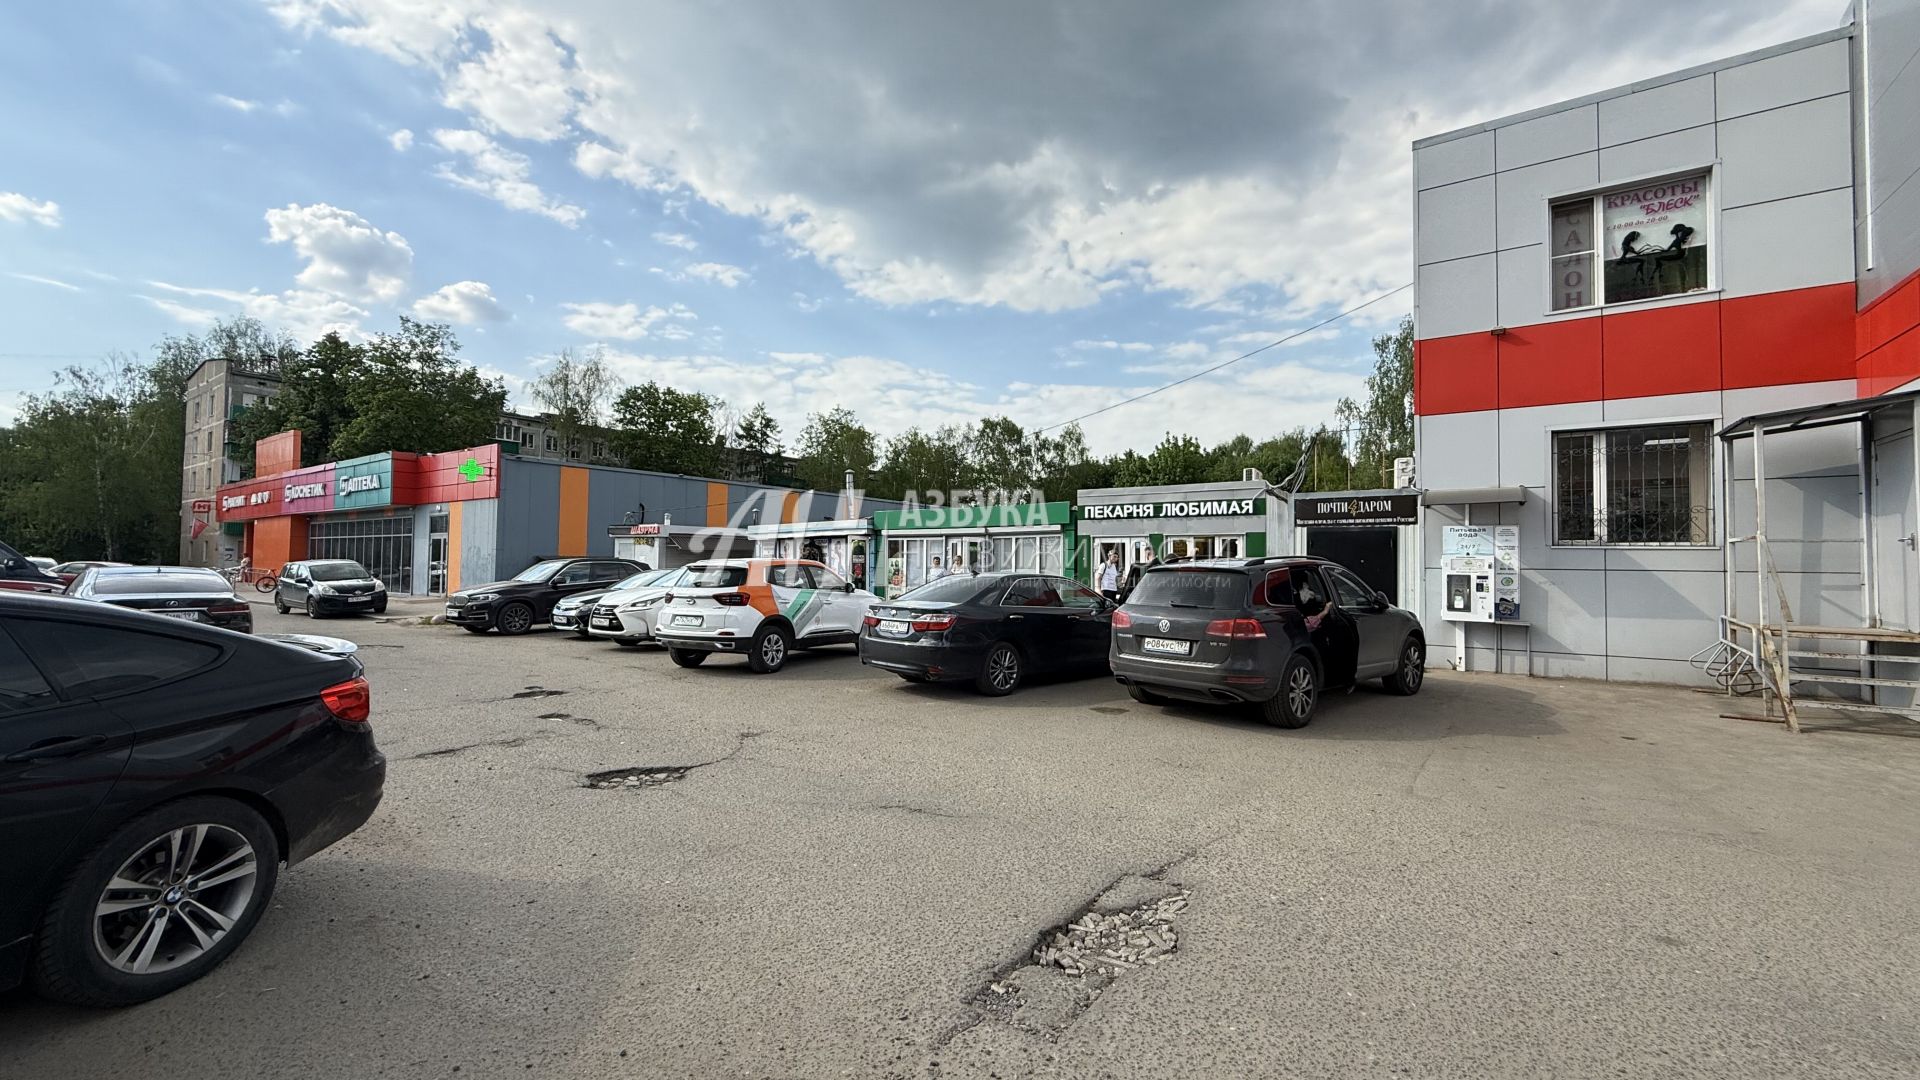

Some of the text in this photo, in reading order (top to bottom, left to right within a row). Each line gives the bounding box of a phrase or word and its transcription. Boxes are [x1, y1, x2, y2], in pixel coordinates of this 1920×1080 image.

[1607, 181, 1698, 209] КРАСОТЫ
[1645, 215, 1668, 225] 20-00
[1564, 213, 1582, 308] САЛОН
[349, 475, 380, 492] АПТЕКА
[1084, 499, 1253, 519] ПЕКАРНЯ ЛЮБИМАЯ
[1317, 500, 1392, 514] ПОЧТИ ДАРОМ
[631, 525, 659, 535] ШАУРМА
[224, 553, 234, 562] 2
[1175, 641, 1188, 649] 197
